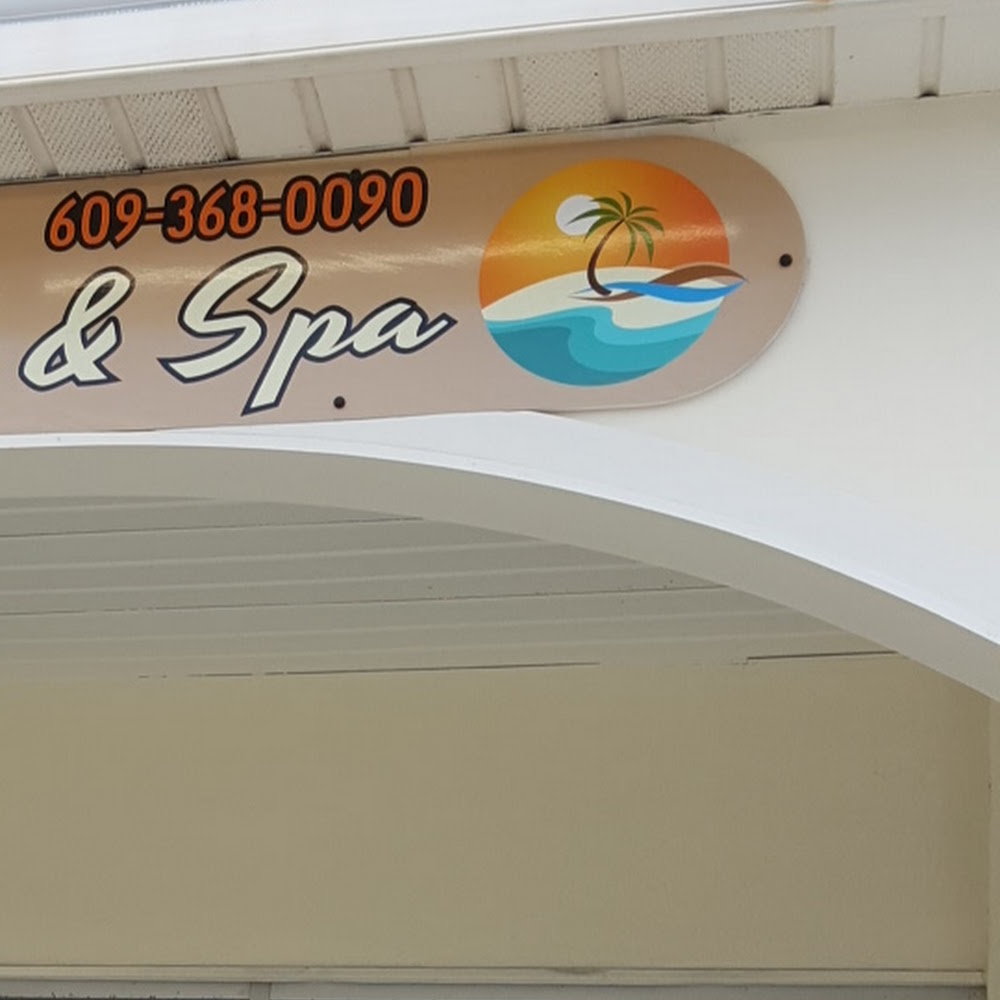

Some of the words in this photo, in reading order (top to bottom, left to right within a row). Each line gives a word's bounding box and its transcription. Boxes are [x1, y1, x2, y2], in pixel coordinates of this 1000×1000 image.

[45, 166, 429, 251] 609-368-0090
[18, 266, 135, 391] &
[158, 246, 457, 415] Spa
